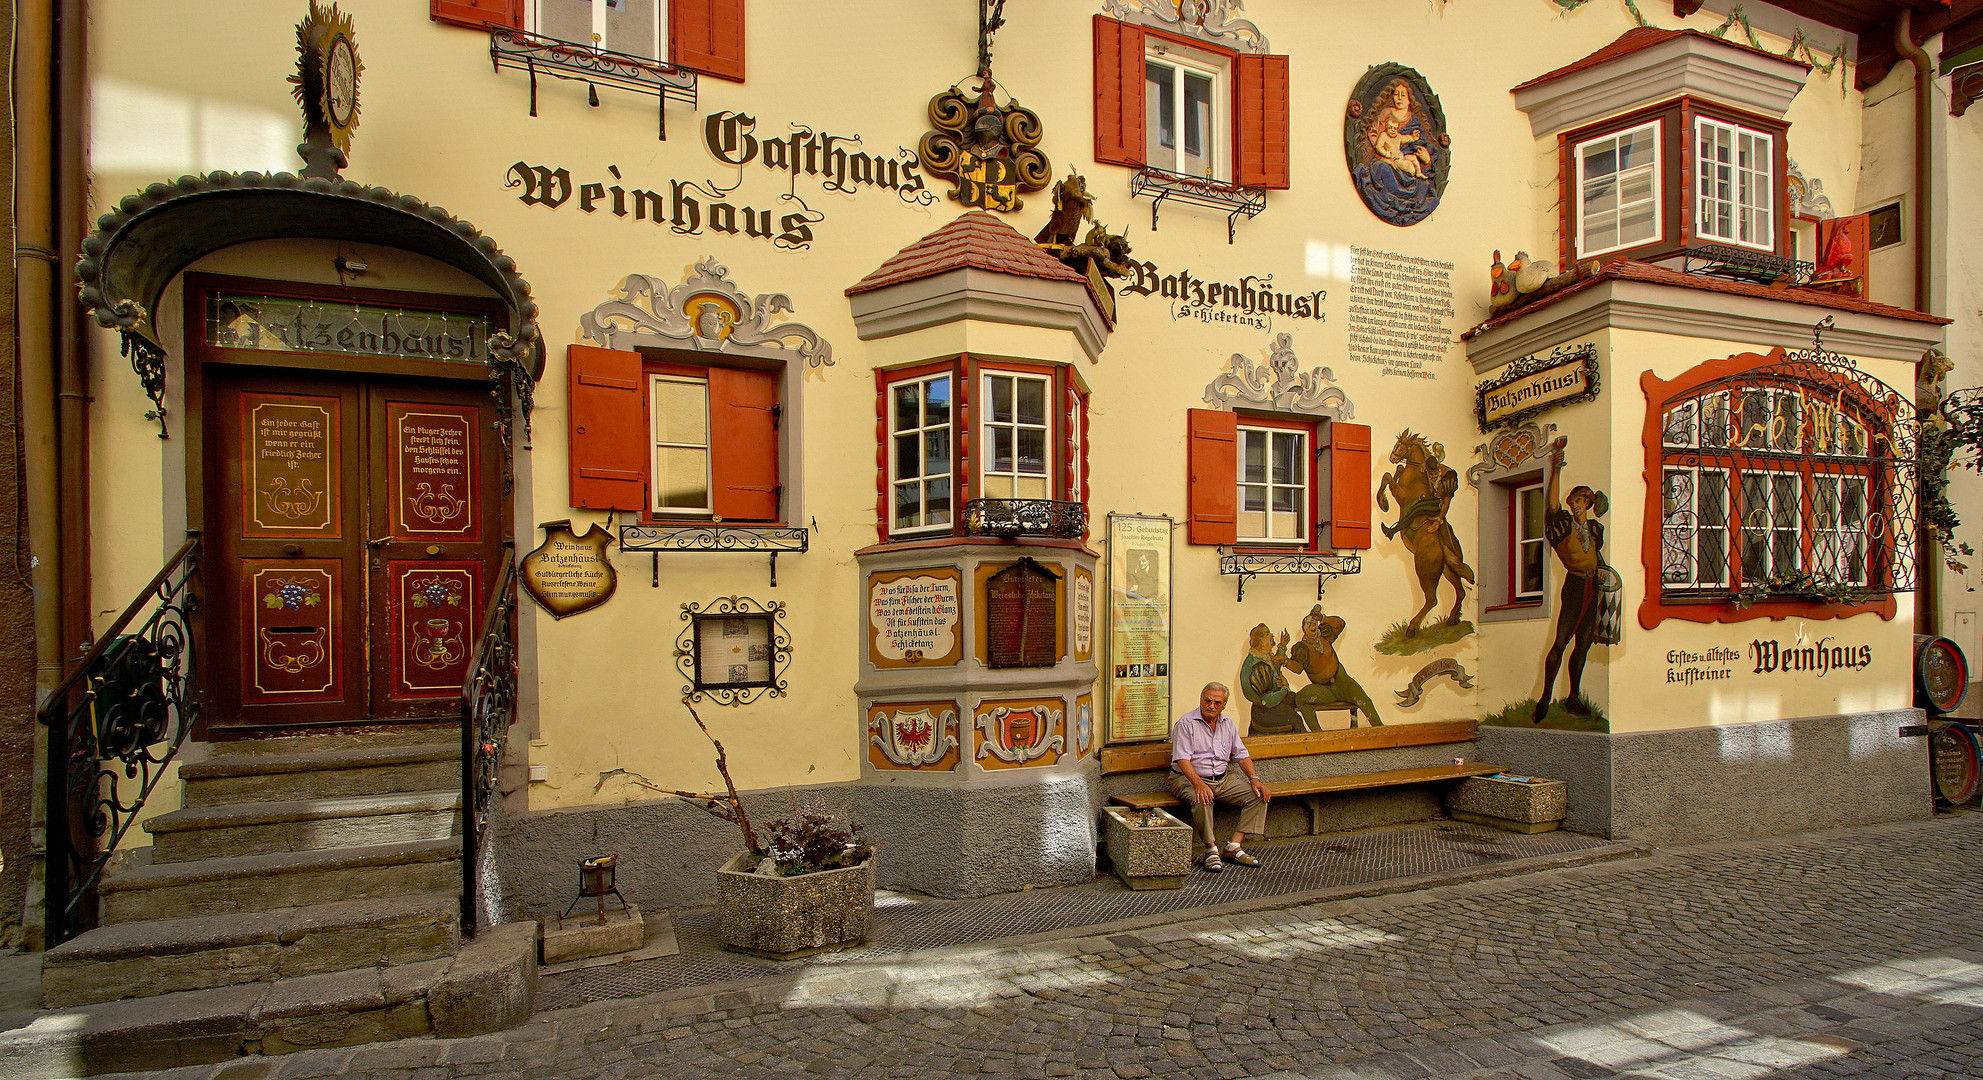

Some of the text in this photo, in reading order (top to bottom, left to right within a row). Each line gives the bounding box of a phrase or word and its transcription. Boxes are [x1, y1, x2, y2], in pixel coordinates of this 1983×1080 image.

[705, 111, 936, 205] Gasthaus
[504, 162, 823, 249] Weinhaus
[1119, 258, 1327, 323] Batzenhäusl
[1488, 366, 1581, 412] Batzenhäusl
[296, 450, 321, 459] Zecher
[405, 445, 418, 453] den
[419, 446, 451, 455] Schlüssel
[413, 467, 446, 475] morgens
[1136, 526, 1168, 535] Geburtstag
[553, 541, 593, 551] Weinhaus
[540, 553, 598, 564] Batzenhäusl
[584, 571, 604, 579] Küche
[896, 585, 906, 595] für
[905, 585, 919, 595] Pisa
[919, 584, 930, 592] der
[901, 595, 923, 606] Fischer
[923, 595, 934, 603] der
[875, 609, 891, 617] Was
[892, 607, 905, 616] dem
[904, 605, 931, 616] Edelstein
[936, 605, 956, 615] Glanz
[897, 618, 907, 628] für
[934, 617, 947, 625] das
[891, 640, 934, 650] Schicketanz
[1667, 650, 1698, 667] Erstes
[1706, 646, 1741, 666] ältestes
[1748, 637, 1872, 678] Weinhaus
[1665, 666, 1732, 686] Kufsteiner
